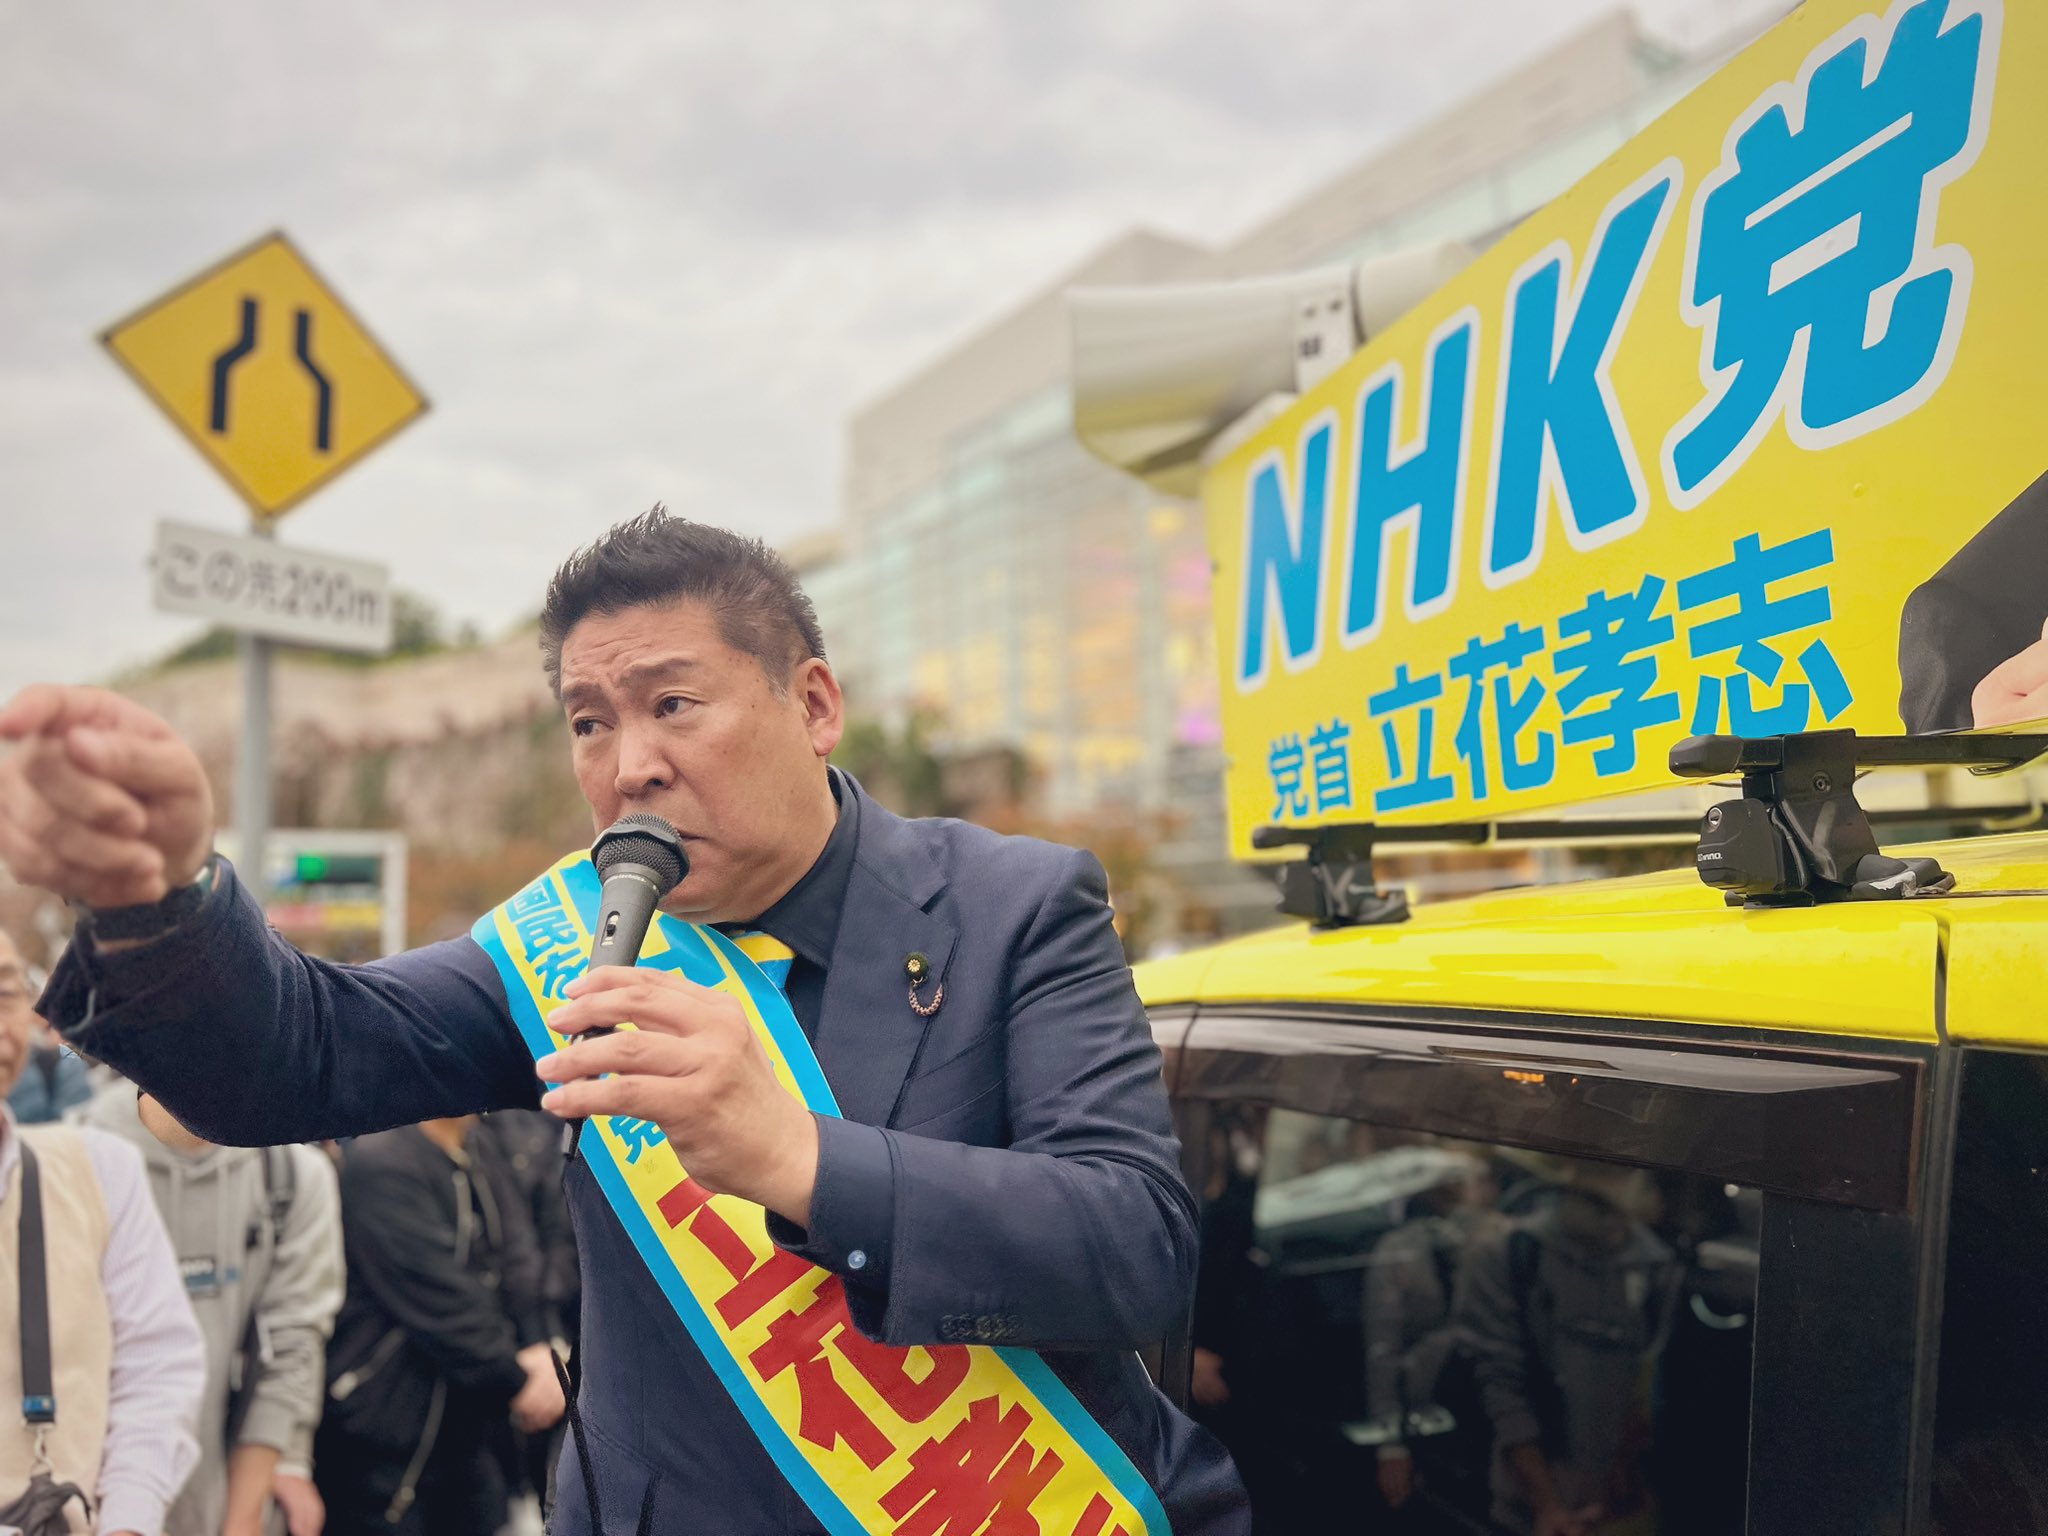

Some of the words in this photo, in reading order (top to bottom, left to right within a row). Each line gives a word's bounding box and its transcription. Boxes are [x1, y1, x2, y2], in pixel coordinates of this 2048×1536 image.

[1238, 0, 1985, 684] NHK党
[1267, 717, 1354, 821] 党首
[1368, 527, 1855, 813] 立花孝志
[656, 1178, 1133, 1536] 立花孝
